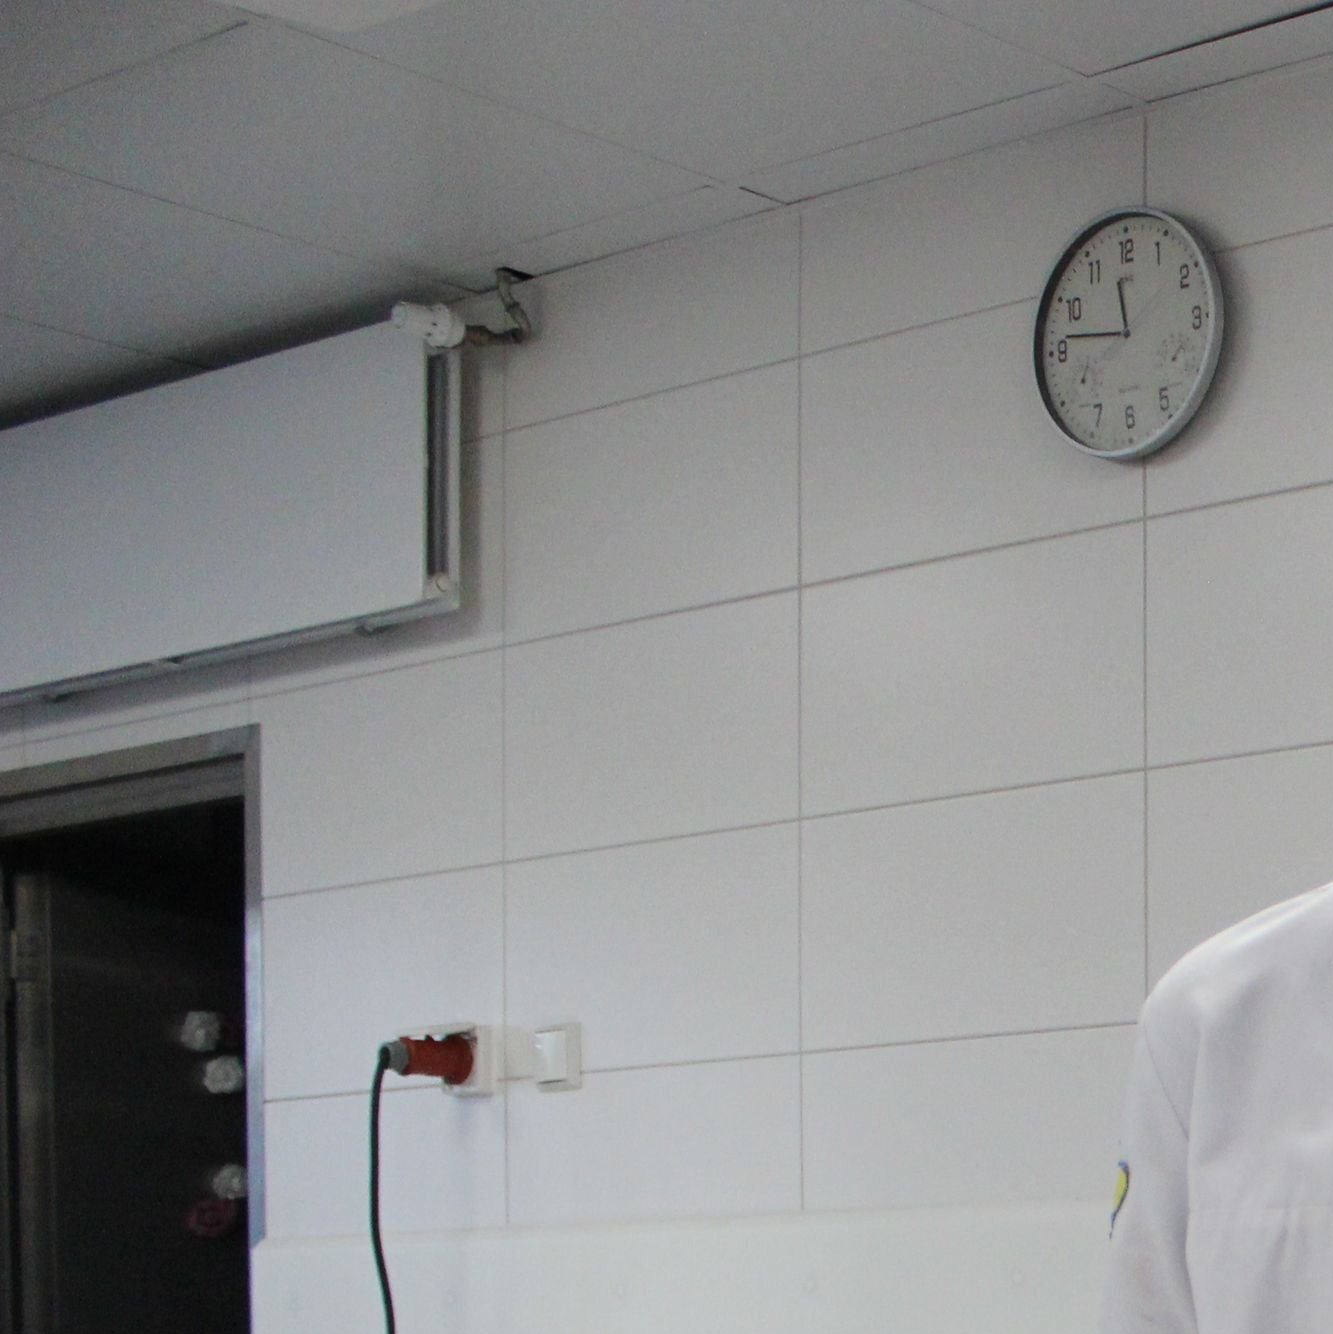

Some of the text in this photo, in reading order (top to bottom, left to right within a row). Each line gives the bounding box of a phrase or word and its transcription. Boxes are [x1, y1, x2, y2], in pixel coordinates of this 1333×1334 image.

[1117, 238, 1135, 264] 12
[1154, 241, 1161, 265] 1
[1088, 260, 1100, 284] 11
[1179, 263, 1190, 289] 2
[1066, 297, 1081, 322] 10
[1191, 305, 1202, 330] 3
[1057, 340, 1067, 362] 9
[1158, 387, 1169, 411] 5
[1093, 403, 1103, 427] 7
[1124, 405, 1135, 429] 6
